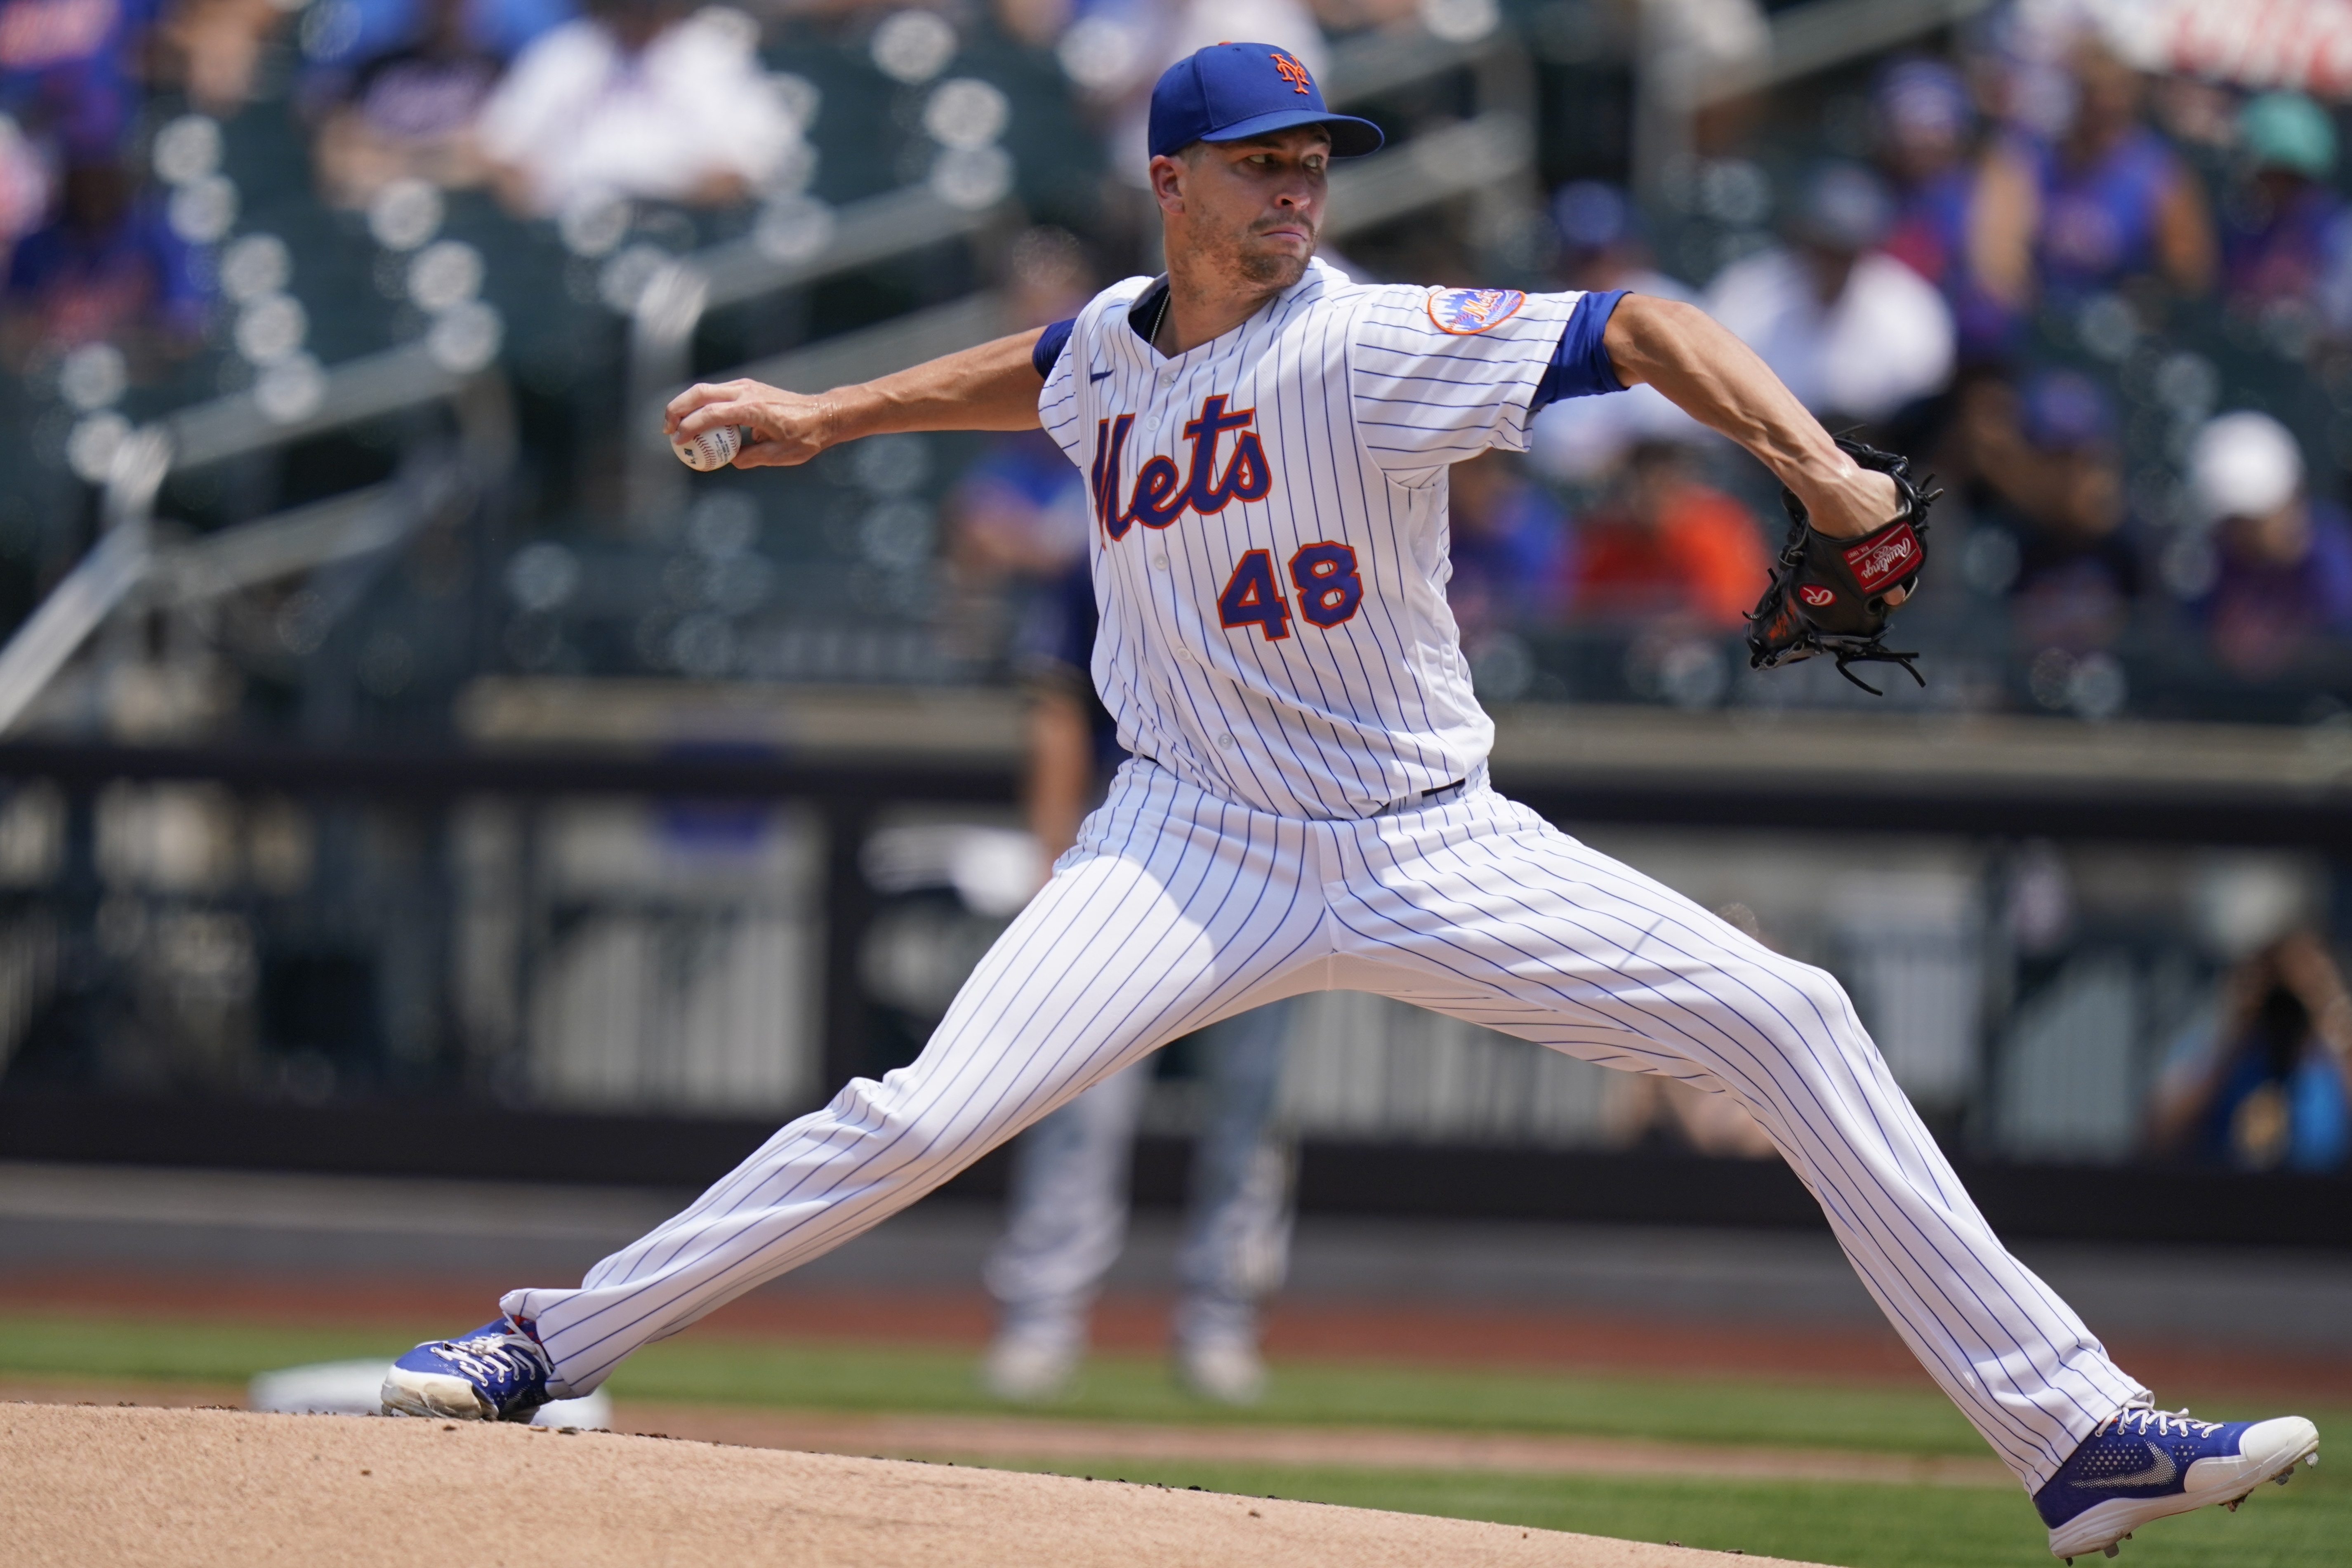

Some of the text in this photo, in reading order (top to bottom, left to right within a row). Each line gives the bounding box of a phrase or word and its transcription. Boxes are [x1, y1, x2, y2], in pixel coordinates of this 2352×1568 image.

[1269, 54, 1310, 95] NY
[1461, 290, 1504, 324] Mets
[1092, 393, 1272, 551] Mets
[1861, 537, 1911, 579] Rawlings
[1217, 540, 1363, 641] 48
[1803, 587, 1833, 605] R
